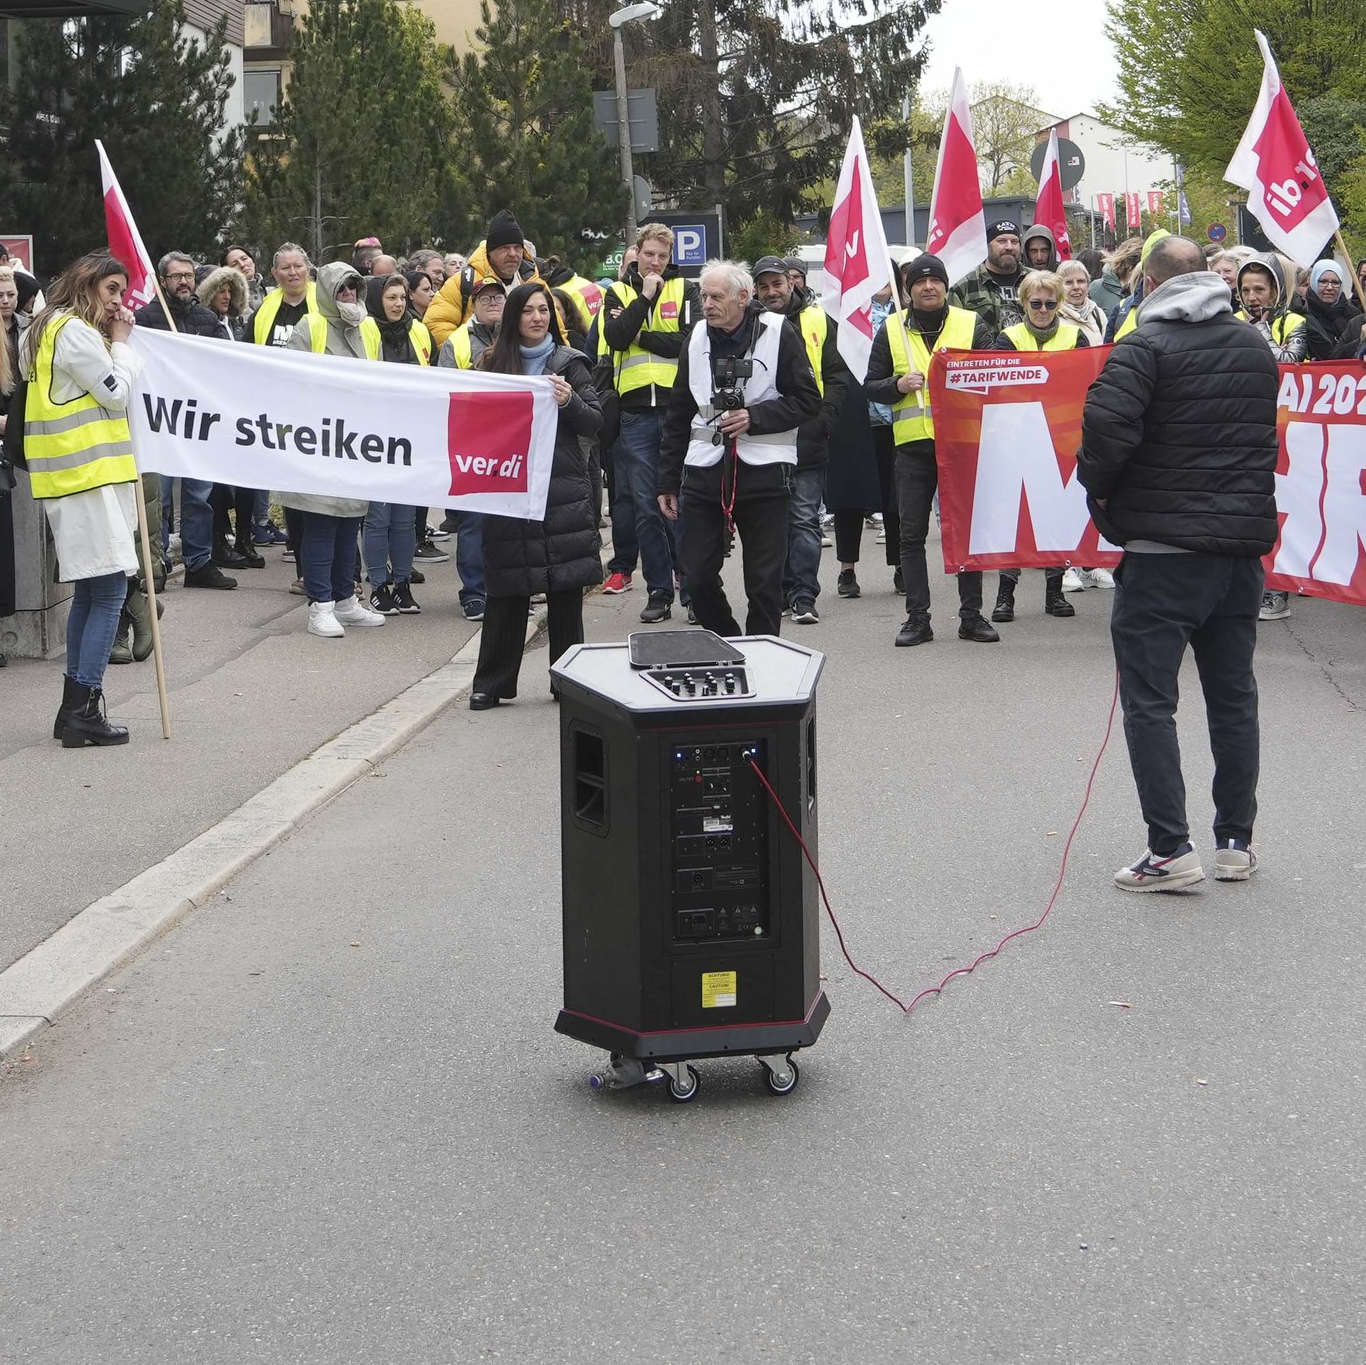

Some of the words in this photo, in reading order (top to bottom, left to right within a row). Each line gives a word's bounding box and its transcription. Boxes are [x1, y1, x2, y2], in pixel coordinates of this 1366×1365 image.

[677, 230, 701, 261] P
[946, 359, 990, 368] EINTRETEN
[990, 357, 1006, 366] FÜR
[950, 369, 1041, 384] #TARIFWENDE
[1276, 372, 1313, 413] AI
[141, 392, 221, 441] Wir
[235, 413, 412, 467] streiken
[454, 453, 523, 480] ver.di
